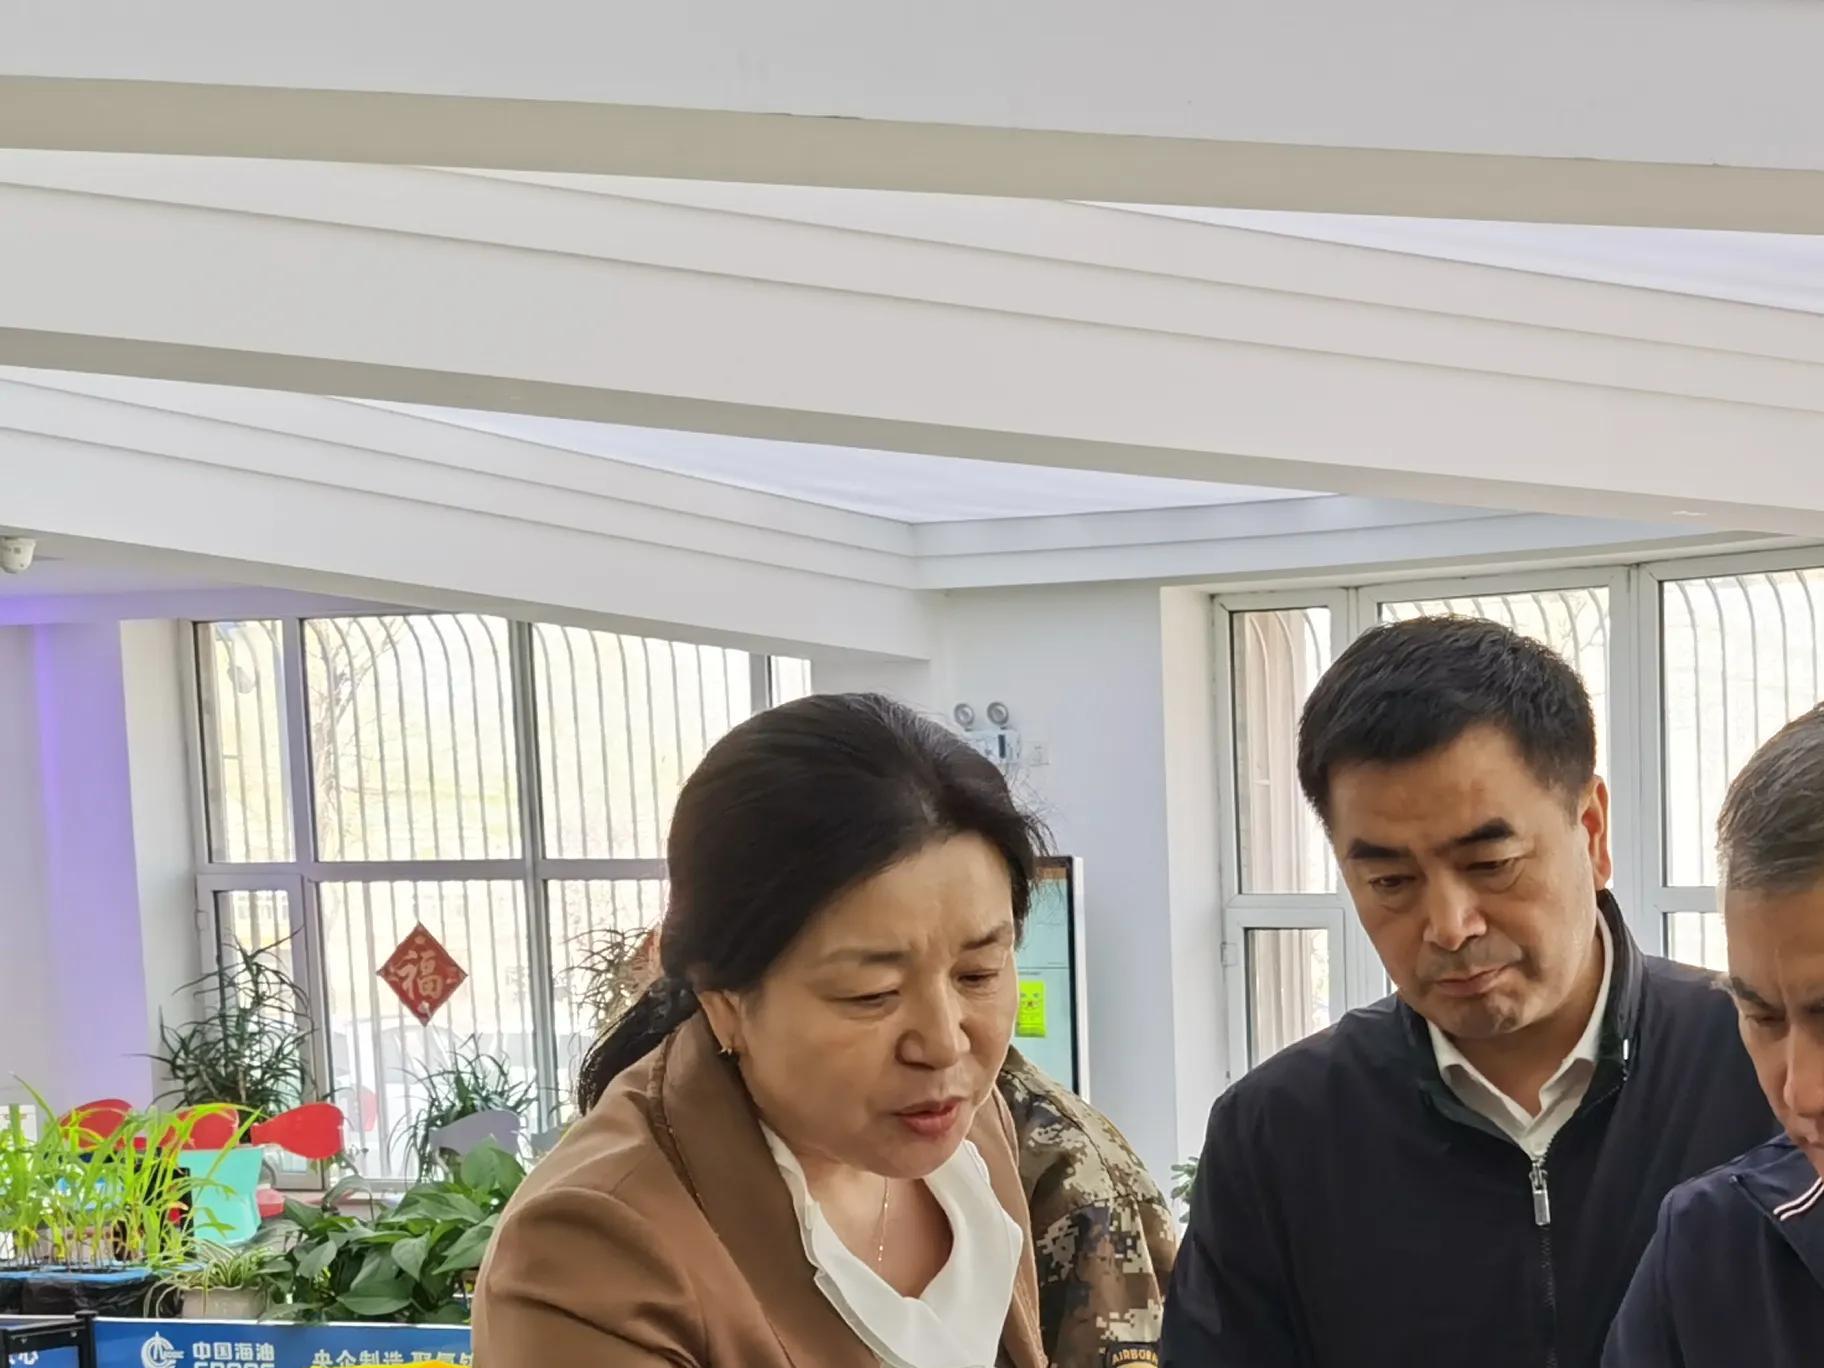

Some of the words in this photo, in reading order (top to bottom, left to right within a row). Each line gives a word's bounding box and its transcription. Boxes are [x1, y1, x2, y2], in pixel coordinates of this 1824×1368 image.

[395, 950, 443, 1000] 福
[192, 1341, 275, 1361] 中国海油
